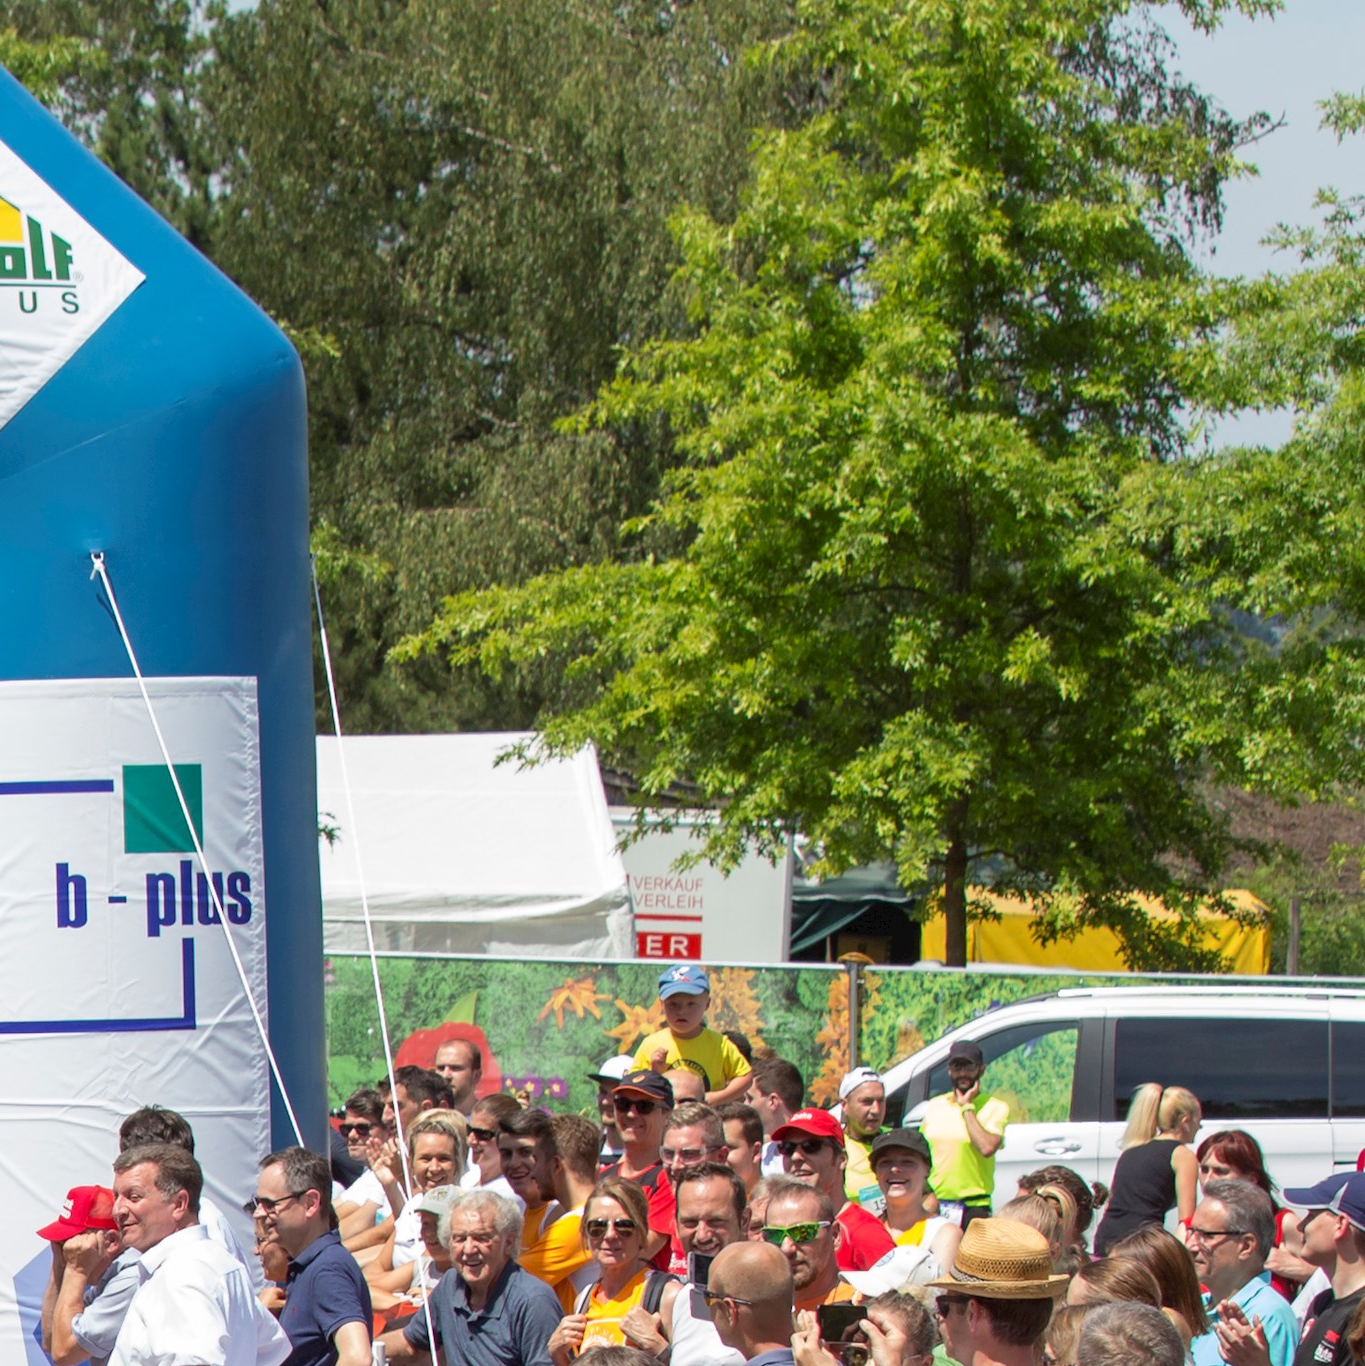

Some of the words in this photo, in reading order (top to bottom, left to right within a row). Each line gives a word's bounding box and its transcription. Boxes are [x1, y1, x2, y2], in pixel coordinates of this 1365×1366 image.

[634, 876, 703, 892] VERKAUF
[147, 859, 252, 938] plus
[634, 893, 703, 908] VERLEIH
[636, 934, 689, 957] ER
